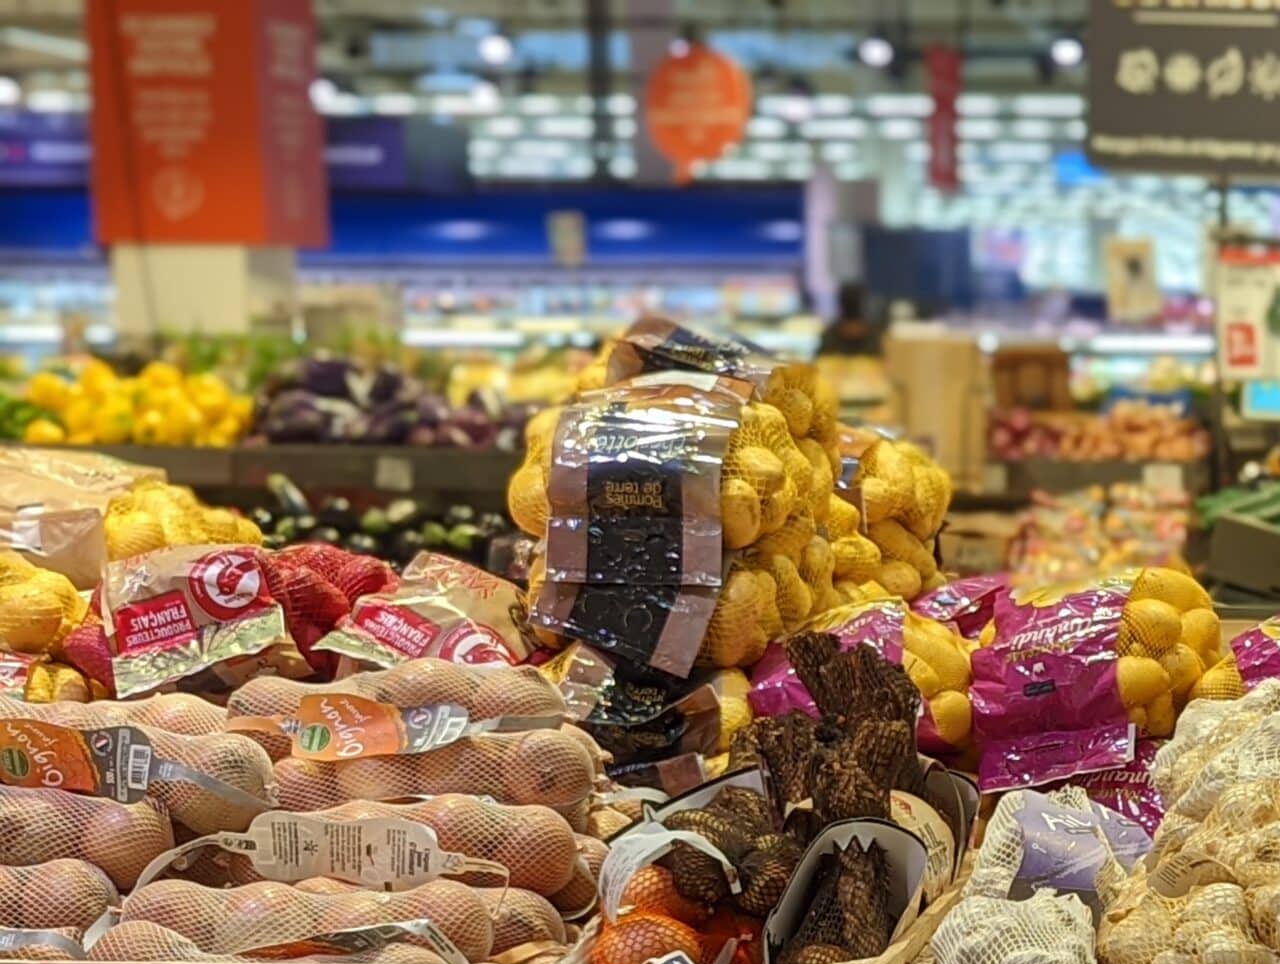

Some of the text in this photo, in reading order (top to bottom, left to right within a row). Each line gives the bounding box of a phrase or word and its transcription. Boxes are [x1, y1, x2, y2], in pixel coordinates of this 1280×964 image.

[605, 480, 662, 495] de terre
[605, 492, 663, 509] Pommes
[130, 602, 187, 632] FRANÇAIS
[375, 611, 432, 647] FRANÇAIS
[125, 619, 192, 647] PRODUCTEURS
[320, 698, 365, 757] Oignon
[6, 722, 64, 787] Oignon
